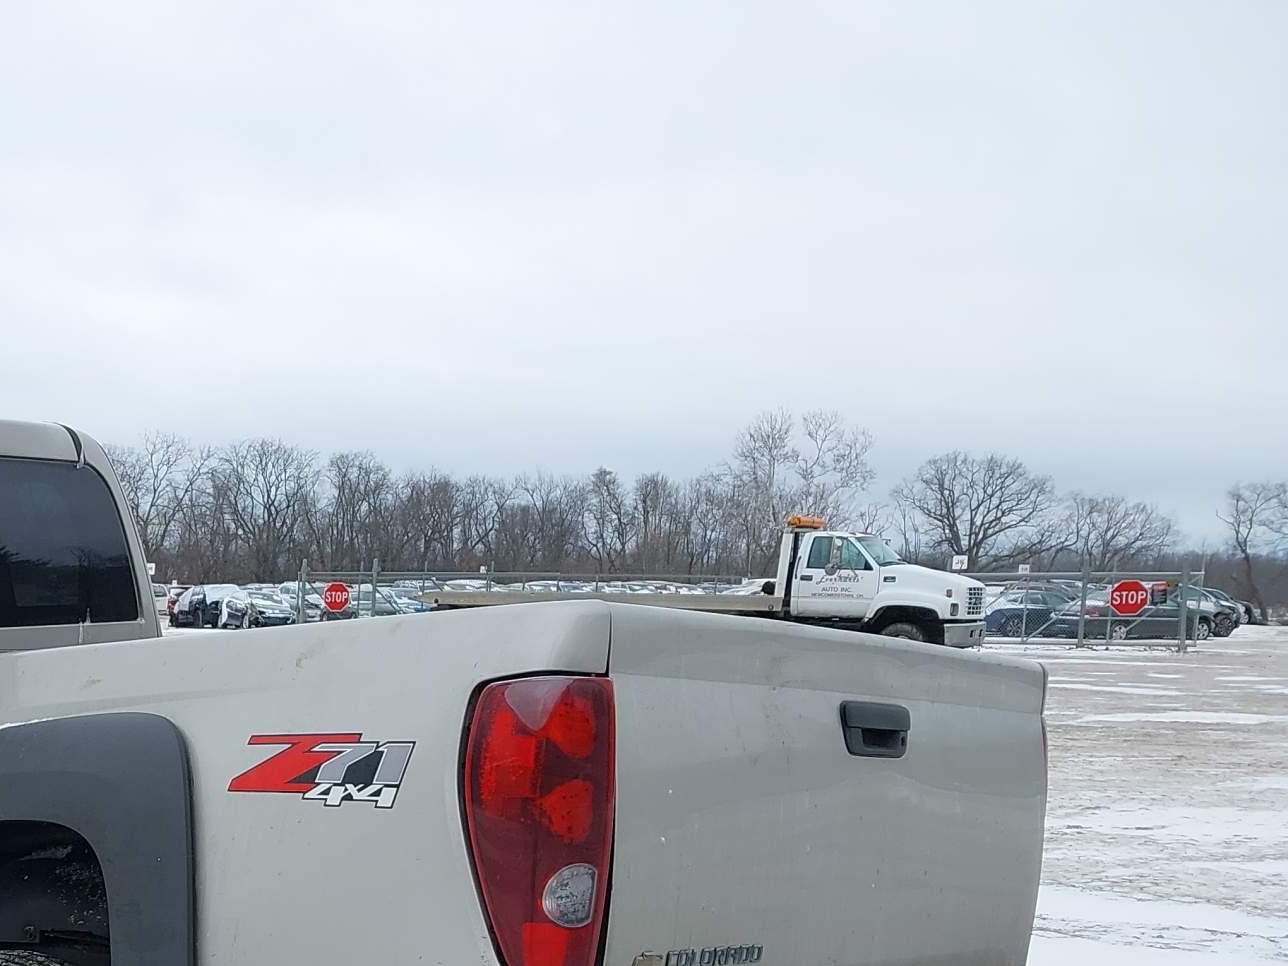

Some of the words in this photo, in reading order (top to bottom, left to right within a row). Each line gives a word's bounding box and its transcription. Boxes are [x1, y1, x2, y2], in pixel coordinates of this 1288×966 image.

[325, 591, 348, 603] STOP
[1112, 590, 1147, 605] STOP
[228, 732, 417, 793] Z71
